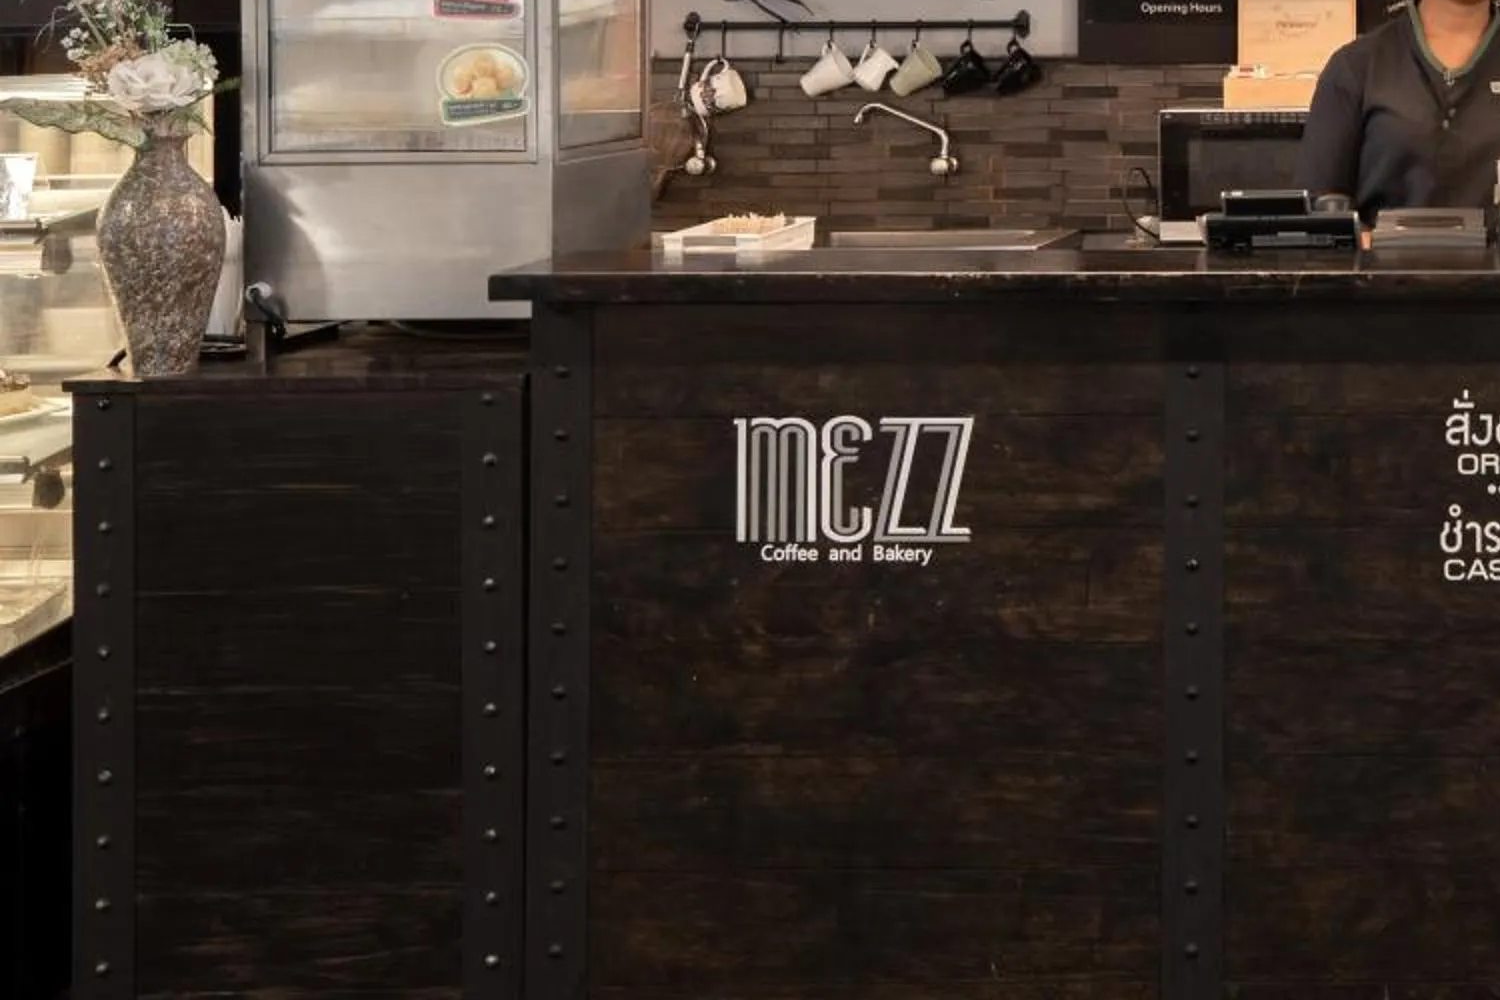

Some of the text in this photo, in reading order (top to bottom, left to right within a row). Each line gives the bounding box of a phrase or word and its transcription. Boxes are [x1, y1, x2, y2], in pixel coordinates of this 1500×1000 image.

[1141, 2, 1222, 14] Opening Hours
[761, 544, 932, 566] Coffee and Bakery
